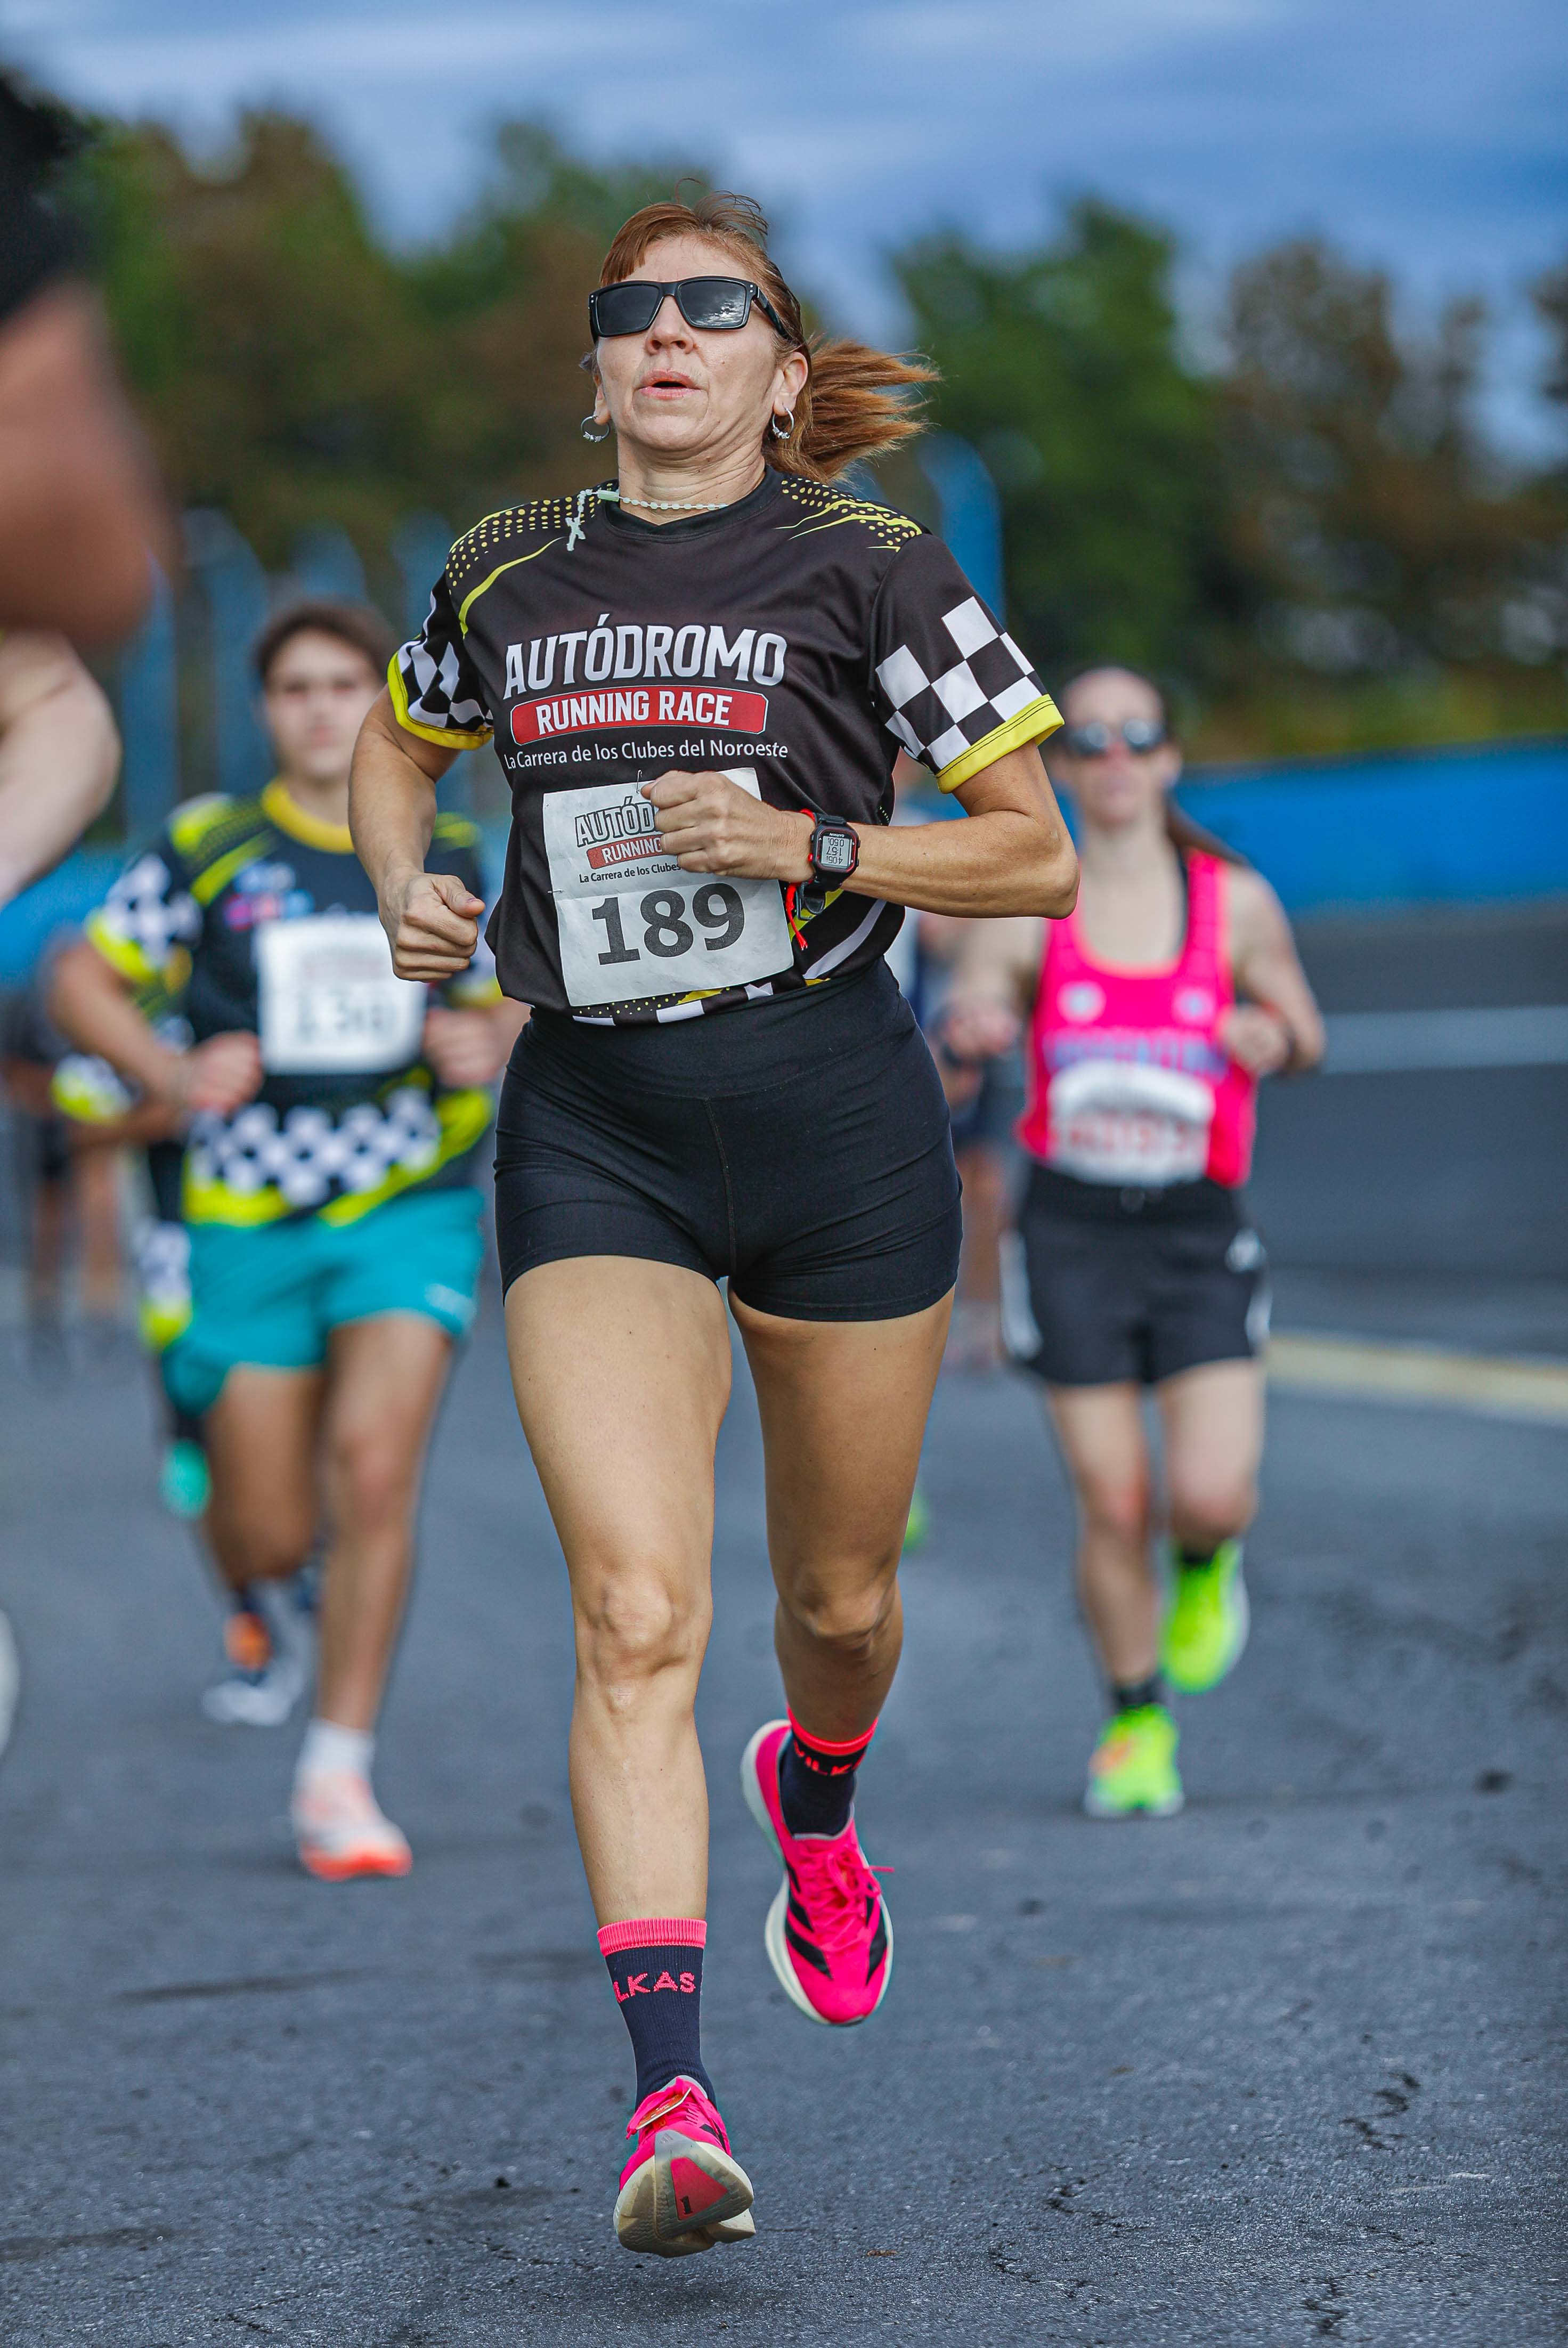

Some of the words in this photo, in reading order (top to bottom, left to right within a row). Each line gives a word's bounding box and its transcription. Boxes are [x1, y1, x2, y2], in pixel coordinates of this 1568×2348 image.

[503, 613, 787, 700] AUTÓDROMO
[535, 690, 650, 736] RUNNING
[659, 690, 733, 726] RACE
[504, 754, 516, 769] La
[517, 751, 567, 768] Carrera
[572, 745, 592, 761] de
[595, 744, 618, 760] los
[622, 741, 675, 759] Clubes
[679, 739, 705, 757] del
[710, 740, 789, 758] Noroeste
[575, 795, 656, 848] AUTÓD
[601, 837, 663, 864] RUNNING
[826, 846, 842, 856] 1:57
[579, 873, 589, 883] La
[590, 871, 622, 882] Carrera
[624, 868, 636, 878] de
[636, 866, 649, 875] los
[651, 863, 682, 873] Clubes
[591, 883, 745, 966] 189
[613, 1970, 696, 2003] LKAS
[680, 2196, 693, 2214] 1
